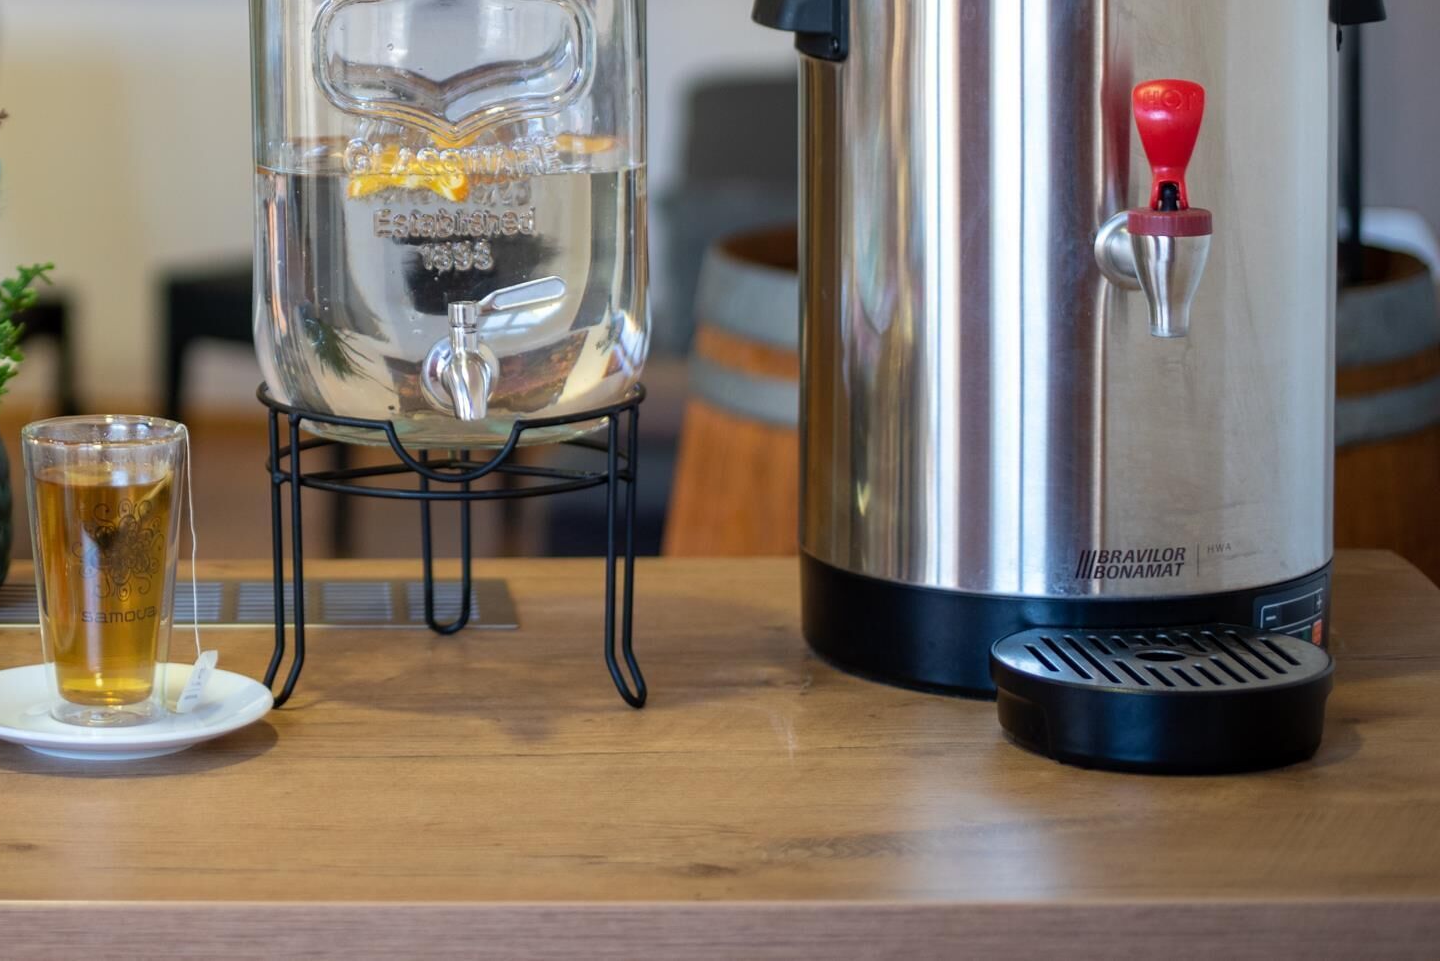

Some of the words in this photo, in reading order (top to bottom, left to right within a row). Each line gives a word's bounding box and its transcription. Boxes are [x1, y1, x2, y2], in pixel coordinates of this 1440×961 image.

[1142, 89, 1196, 111] HOT
[373, 207, 536, 238] Established
[1097, 547, 1186, 564] BRAVILOR
[1207, 543, 1232, 554] HWA
[1093, 562, 1185, 579] BONAMAT
